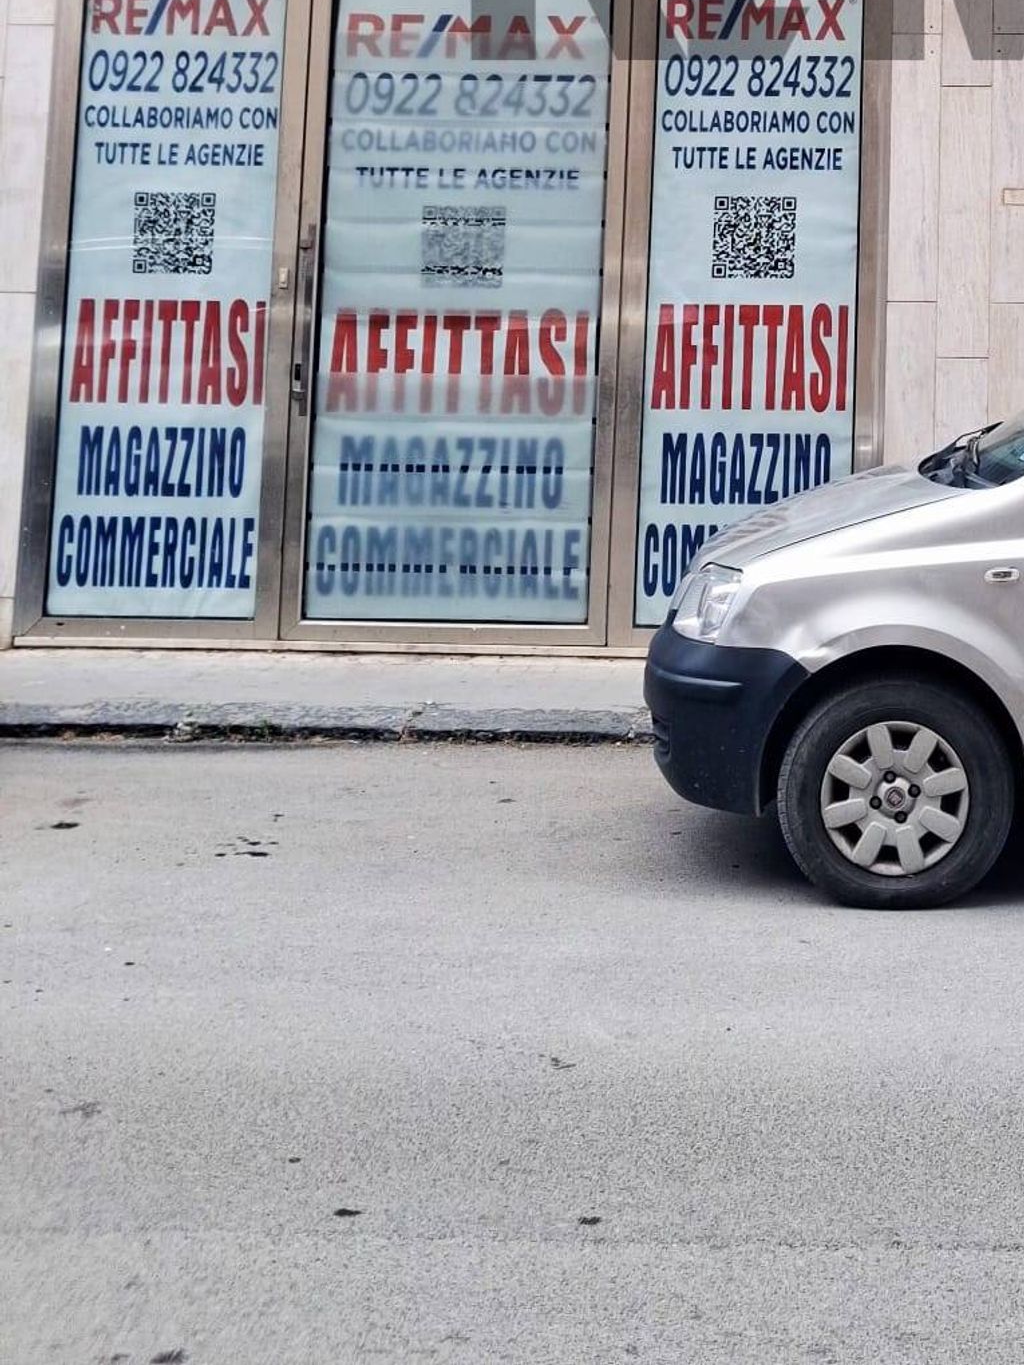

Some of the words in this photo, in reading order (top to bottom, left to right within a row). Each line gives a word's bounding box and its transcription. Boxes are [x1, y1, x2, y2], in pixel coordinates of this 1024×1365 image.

[346, 13, 587, 59] RE/MAX
[88, 49, 164, 93] 0922
[171, 51, 279, 94] 824332
[665, 54, 739, 97] 0922
[747, 55, 856, 98] 824332
[84, 105, 233, 129] COLLABORIAMO
[239, 107, 279, 129] CON
[345, 72, 443, 116] 0922
[454, 73, 597, 117] 824332
[341, 129, 536, 153] COLLABORIAMO
[545, 131, 597, 154] CON
[661, 109, 811, 134] COLLABORIAMO
[816, 111, 856, 134] CON
[94, 142, 151, 165] TUTTE
[157, 143, 179, 165] LE
[184, 143, 265, 166] AGENZIE
[672, 146, 729, 170] TUTTE
[735, 147, 757, 170] LE
[762, 147, 843, 171] AGENZIE
[355, 166, 429, 189] TUTTE
[437, 167, 466, 190] LE
[473, 169, 580, 190] AGENZIE
[69, 298, 267, 407] AFFITTASI
[325, 307, 590, 417] AFFITTASI
[650, 303, 849, 413] AFFITTASI
[77, 425, 247, 499] MAGAZZINO
[338, 435, 565, 509] MAGAZZINO
[660, 432, 831, 506] MAGAZZINO
[56, 514, 255, 590] COMMERCIALE
[315, 525, 581, 600] COMMERCIALE
